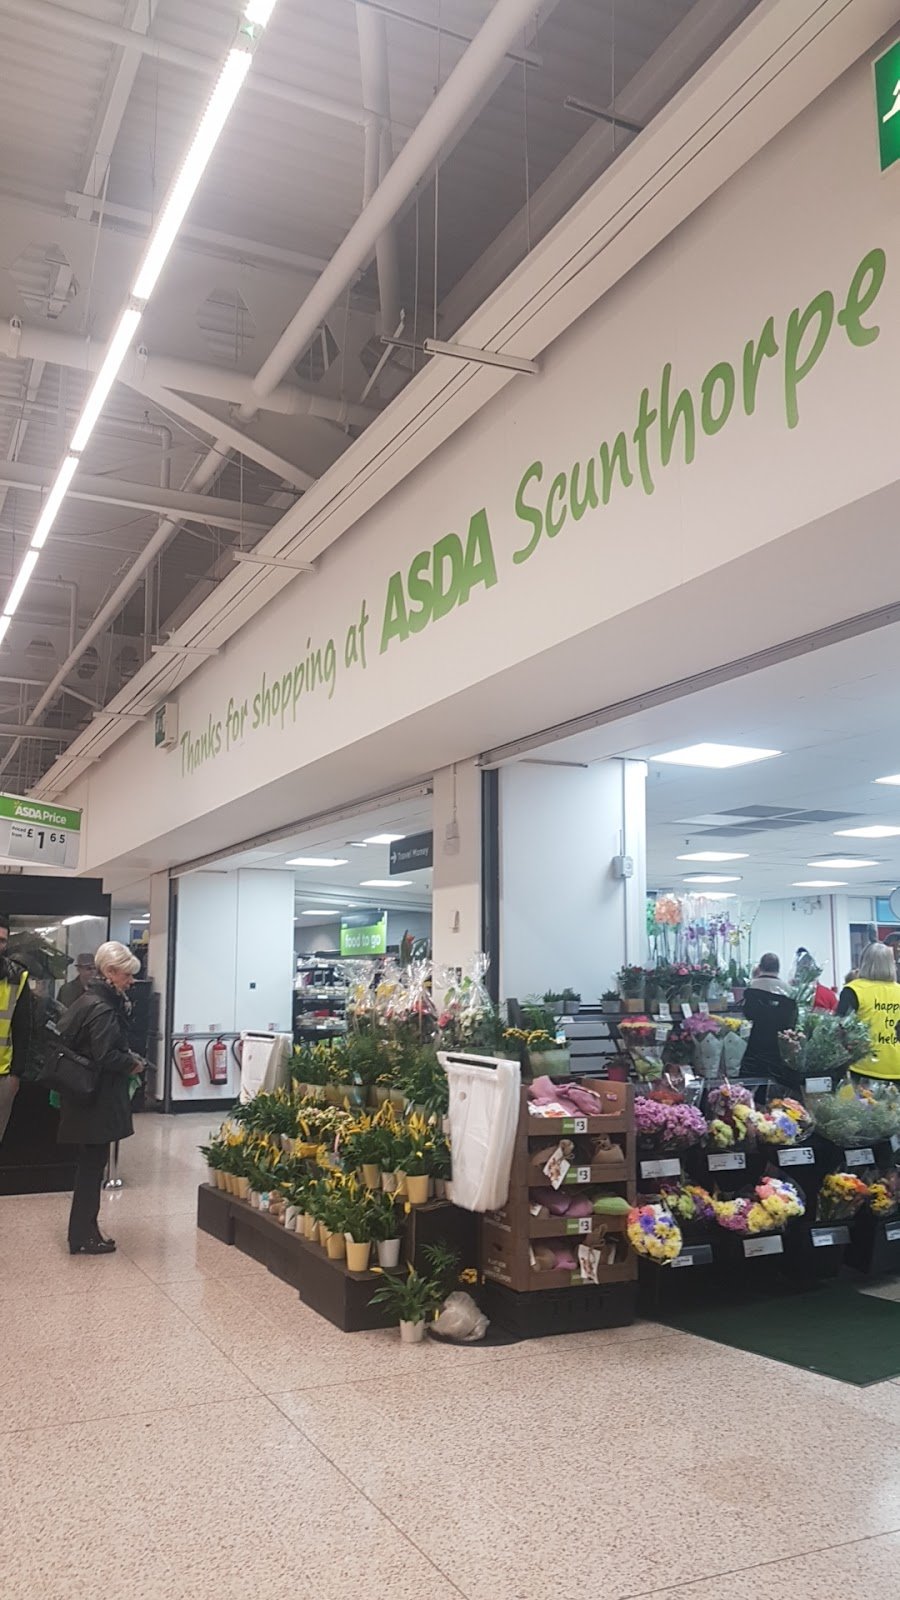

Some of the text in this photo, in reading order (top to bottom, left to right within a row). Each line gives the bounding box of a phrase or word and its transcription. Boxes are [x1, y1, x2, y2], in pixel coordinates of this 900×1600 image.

[180, 247, 887, 778] Thanks for shopping at ASDA Scunthorpe
[15, 807, 66, 824] ASDA Price
[345, 933, 381, 949] food to go
[874, 999, 900, 1014] happ
[884, 1017, 895, 1029] to
[576, 1120, 585, 1131] £3
[579, 1169, 588, 1181] £3
[580, 1220, 589, 1232] £3
